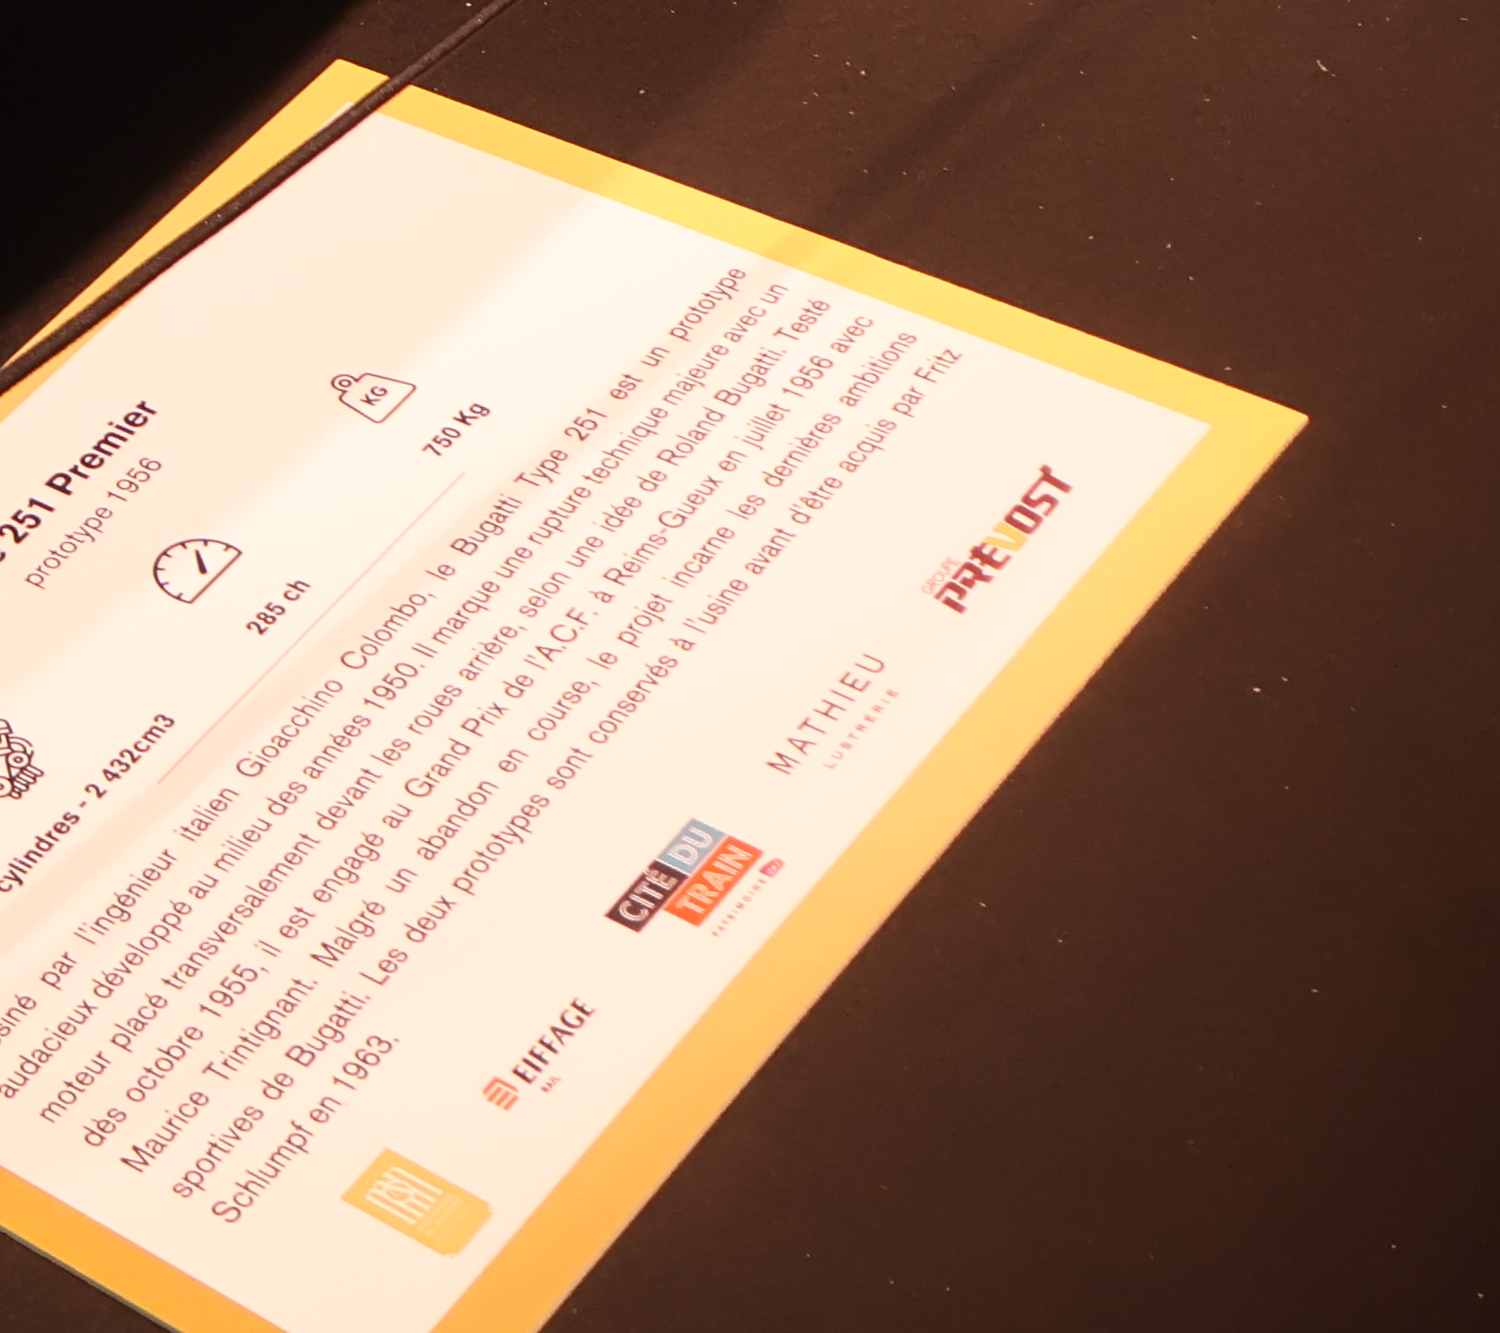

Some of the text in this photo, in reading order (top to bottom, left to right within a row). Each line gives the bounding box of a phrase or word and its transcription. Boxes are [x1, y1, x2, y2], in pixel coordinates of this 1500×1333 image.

[829, 315, 875, 355] avec
[780, 354, 835, 399] 1956
[42, 398, 159, 498] Premier
[420, 401, 493, 458] 750 Kg
[717, 449, 749, 473] en
[733, 402, 792, 452] juillet
[22, 456, 164, 591] prototype 1956
[600, 474, 725, 588] Reims-Gueux
[244, 578, 312, 637] 285 ch
[587, 589, 617, 605] à
[920, 556, 961, 595] GROUPE
[38, 950, 79, 992] par
[72, 847, 179, 947] l'ingénieur
[171, 786, 241, 844] italien
[234, 678, 345, 779] Gioacchino
[338, 592, 438, 671] Colombo,
[423, 562, 457, 583] le
[447, 492, 524, 558] Bugatti
[511, 448, 570, 488] Type
[562, 406, 609, 443] 251
[608, 372, 645, 401] est
[639, 345, 672, 369] un
[667, 267, 748, 344] prototype
[90, 898, 194, 1001] développé
[187, 872, 221, 901] au
[211, 816, 274, 874] milieu
[264, 779, 309, 817] des
[301, 713, 373, 781] années
[362, 661, 427, 711] 1950.
[409, 641, 440, 660] Il
[430, 579, 502, 646] marque
[493, 545, 535, 580] une
[525, 485, 593, 547] rupture
[580, 406, 670, 486] technique
[660, 343, 731, 407] majeure
[722, 304, 768, 344] avec
[758, 283, 790, 306] un
[38, 298, 832, 1125] moteur placé transversalement devant les roues arrière, selon une idée de Roland Bugatti. Testé
[458, 700, 510, 739] Prix
[501, 673, 536, 700] de
[766, 653, 885, 775] MATHIEU
[82, 782, 109, 801] 2
[100, 712, 177, 784] 432cm3
[118, 331, 919, 1175] Maurice Trintignant. Malgré un abandon en course, le projet incarne les dernières ambitions
[823, 689, 899, 769] LUSTRERIE
[170, 347, 963, 1200] sportives de Bugatti. Les deux prototypes sont conservés à l'usine avant d'être acquis par Fritz
[402, 736, 473, 799] Grand
[380, 802, 414, 831] au
[311, 830, 386, 905] engagé
[611, 824, 718, 925] CITÉ DU
[672, 842, 754, 918] TRAIN
[252, 938, 283, 959] il
[277, 905, 318, 941] est
[197, 962, 271, 1019] 1955,
[124, 1025, 205, 1104] octobre
[511, 998, 595, 1085] EIFFAGE
[540, 1075, 562, 1094] RAIL
[81, 1106, 129, 1149] dès
[209, 1033, 401, 1225] Schlumpf en 1963.
